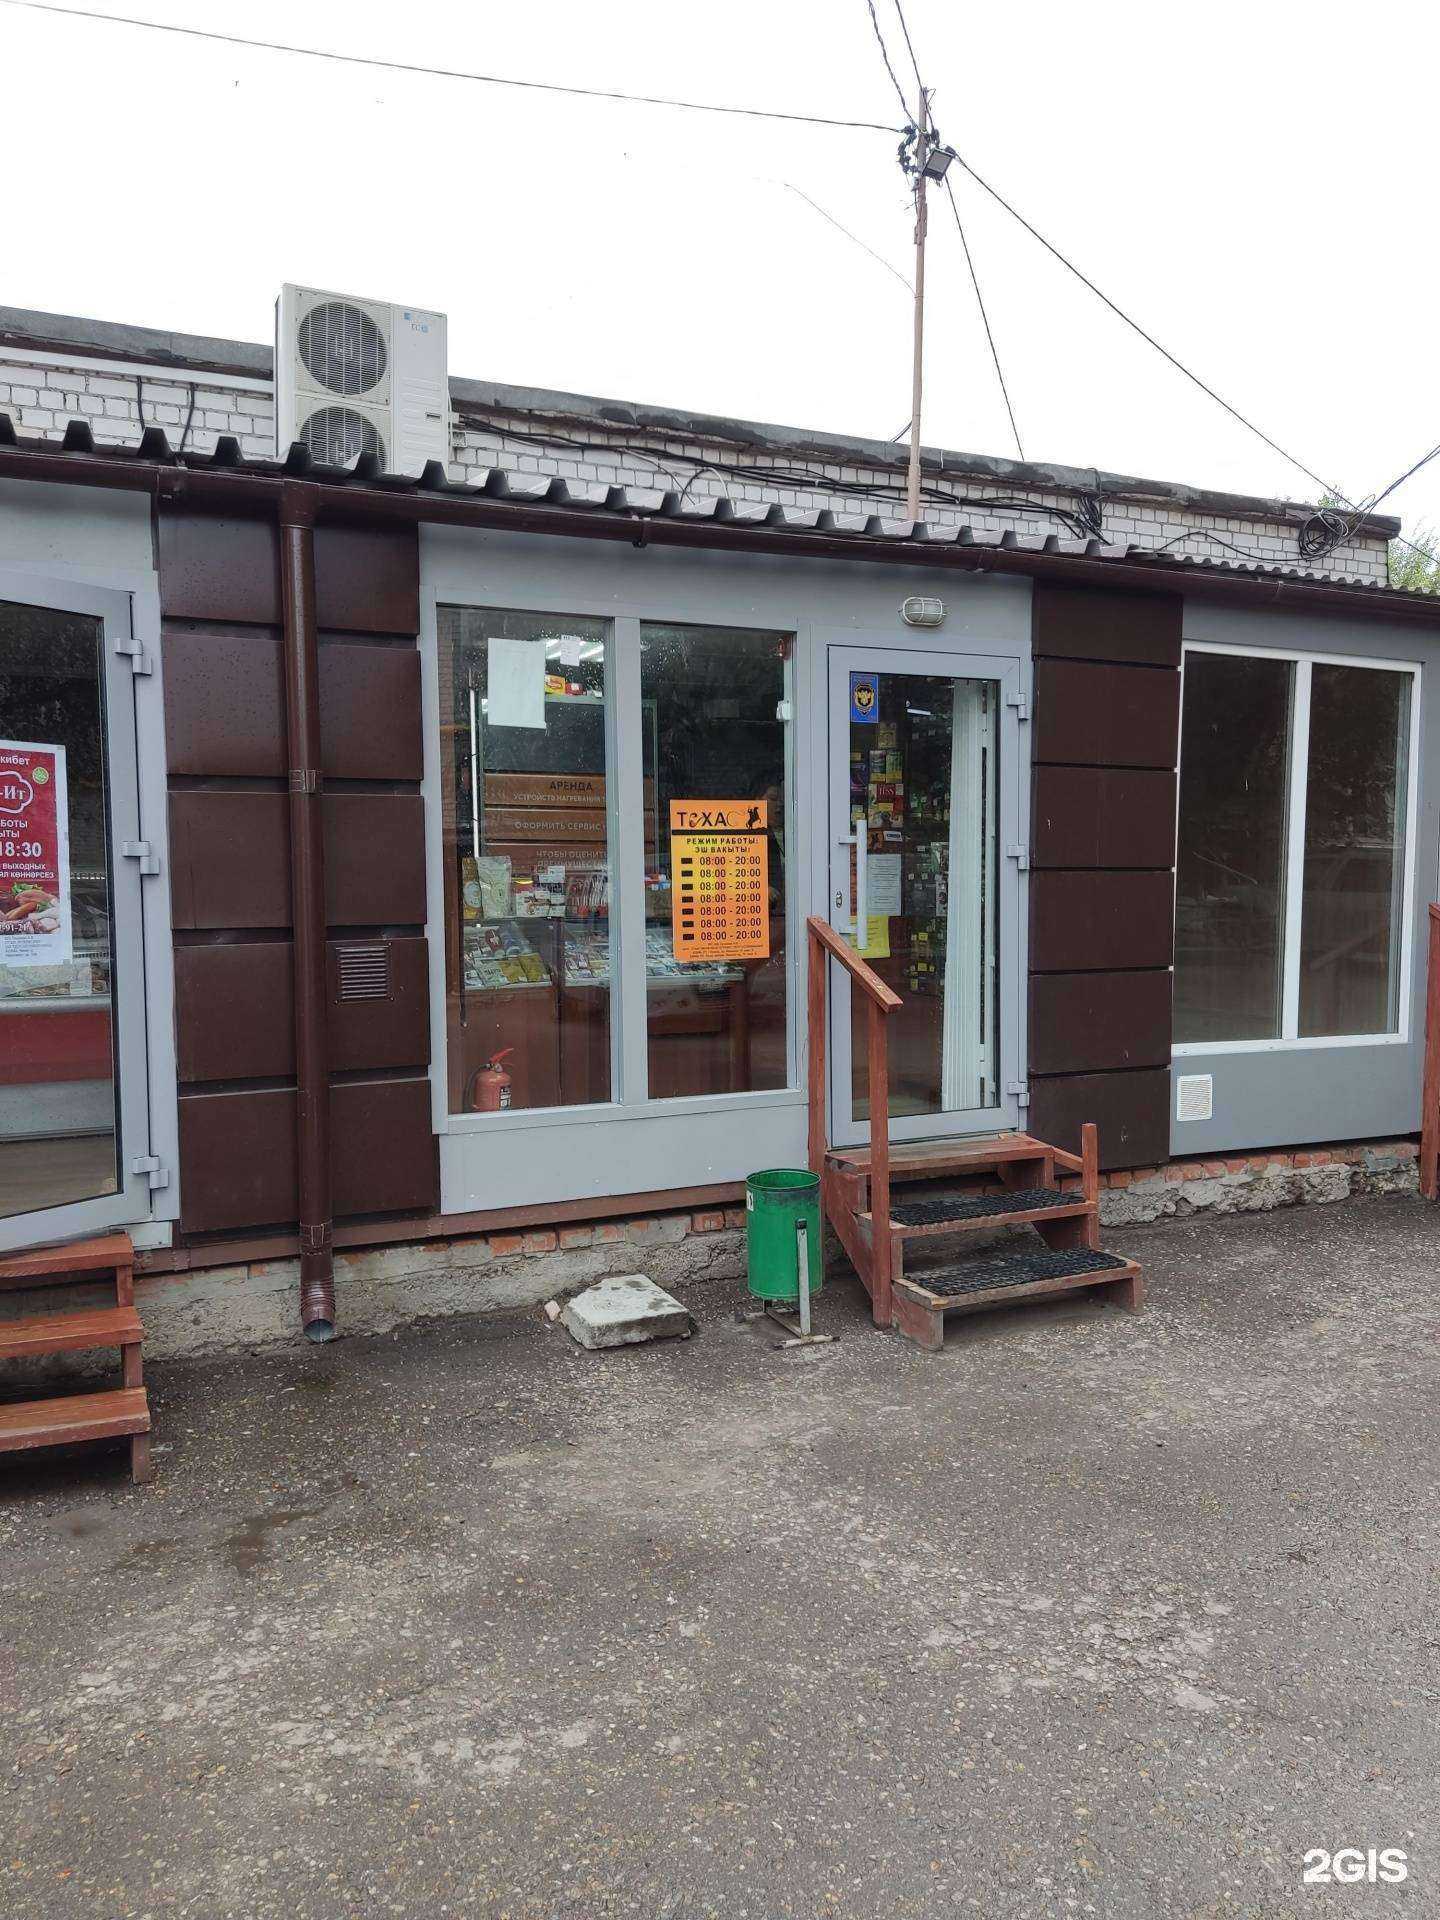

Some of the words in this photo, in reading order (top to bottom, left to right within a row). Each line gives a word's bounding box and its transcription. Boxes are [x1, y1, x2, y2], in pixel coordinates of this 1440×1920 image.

[550, 781, 593, 790] АРЕНДА
[0, 819, 28, 829] БОТЫ
[514, 821, 565, 830] ОФОРМИТЬ
[567, 822, 601, 831] СЕРВИС
[537, 850, 567, 859] ЧТОБЫ
[700, 856, 726, 865] 08:00
[735, 855, 761, 865] 20:00
[2, 862, 46, 871] ВЫХОДНЫХ
[700, 869, 726, 878] 08:00
[735, 868, 761, 877] 20:00
[700, 881, 726, 890] 08:00
[735, 880, 761, 890] 20:00
[700, 894, 726, 903] 08:00
[735, 893, 761, 902] 20:00
[700, 906, 727, 915] 08:00
[735, 905, 761, 914] 20:00
[700, 918, 727, 928] 08:00
[736, 918, 761, 927] 20:00
[700, 931, 727, 940] 08:00
[736, 929, 762, 939] 20:00
